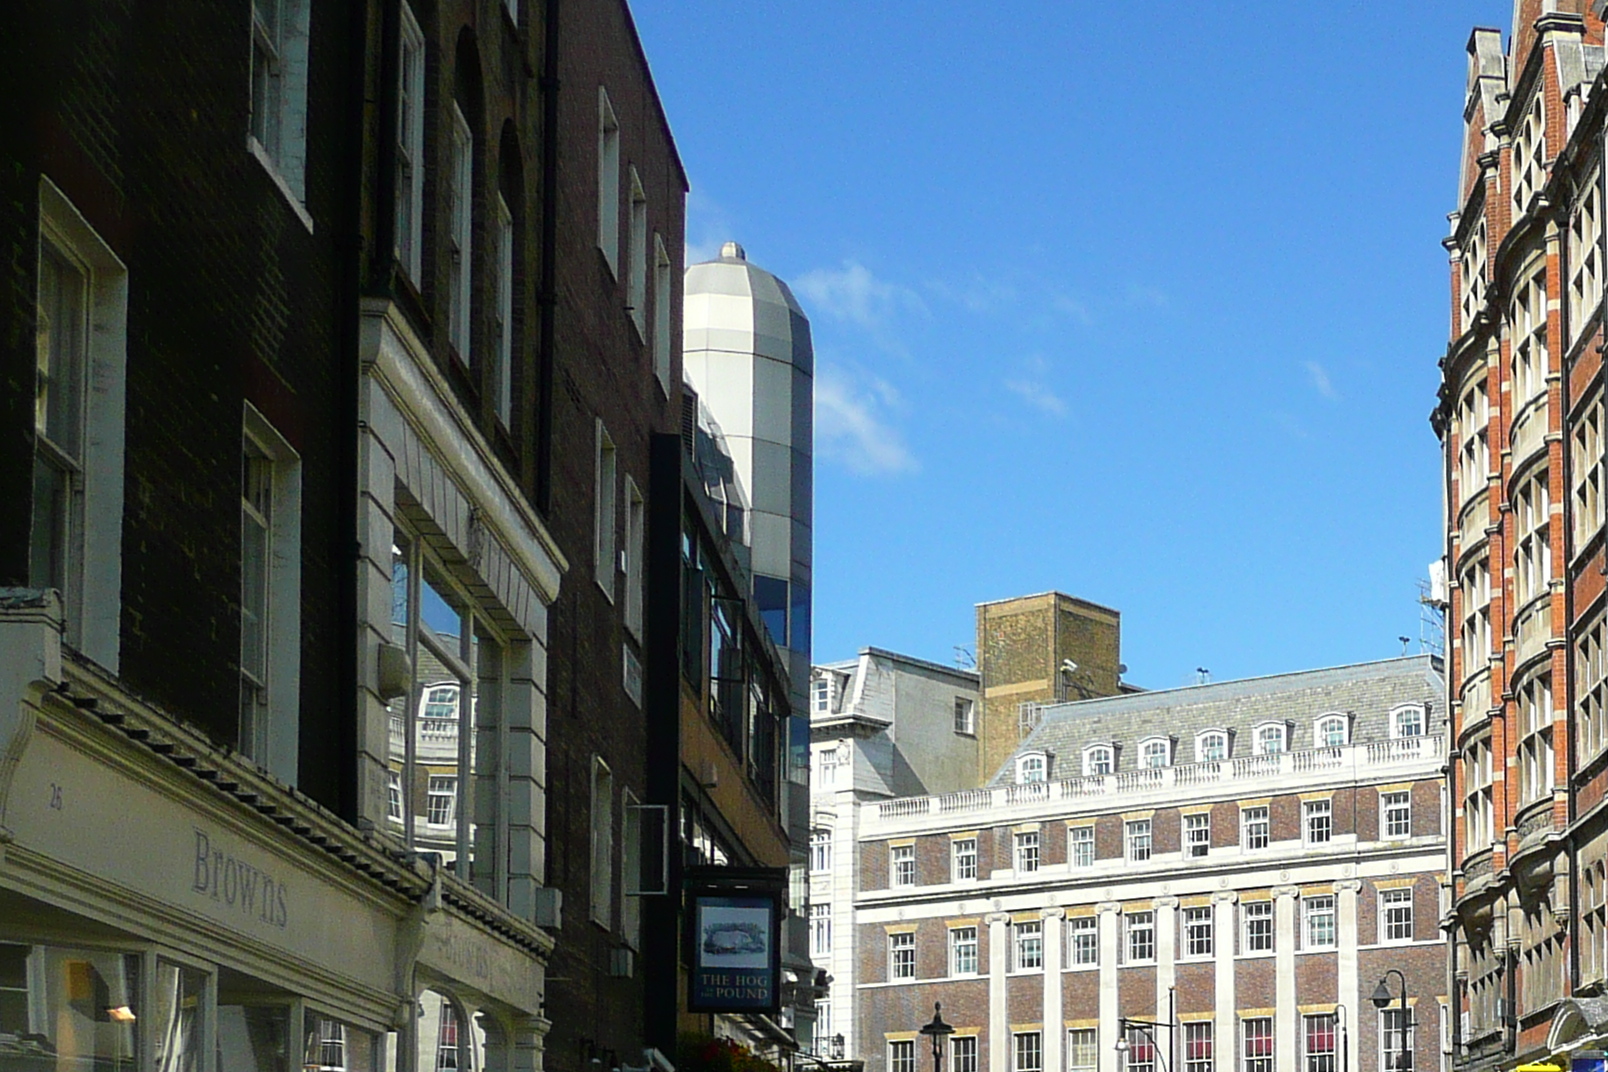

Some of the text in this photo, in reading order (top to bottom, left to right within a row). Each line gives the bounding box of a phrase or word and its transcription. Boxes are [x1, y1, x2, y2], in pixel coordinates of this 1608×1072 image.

[50, 783, 62, 810] 26
[193, 827, 288, 930] Browns
[701, 974, 767, 987] THE HOG
[716, 987, 768, 1000] POUND
